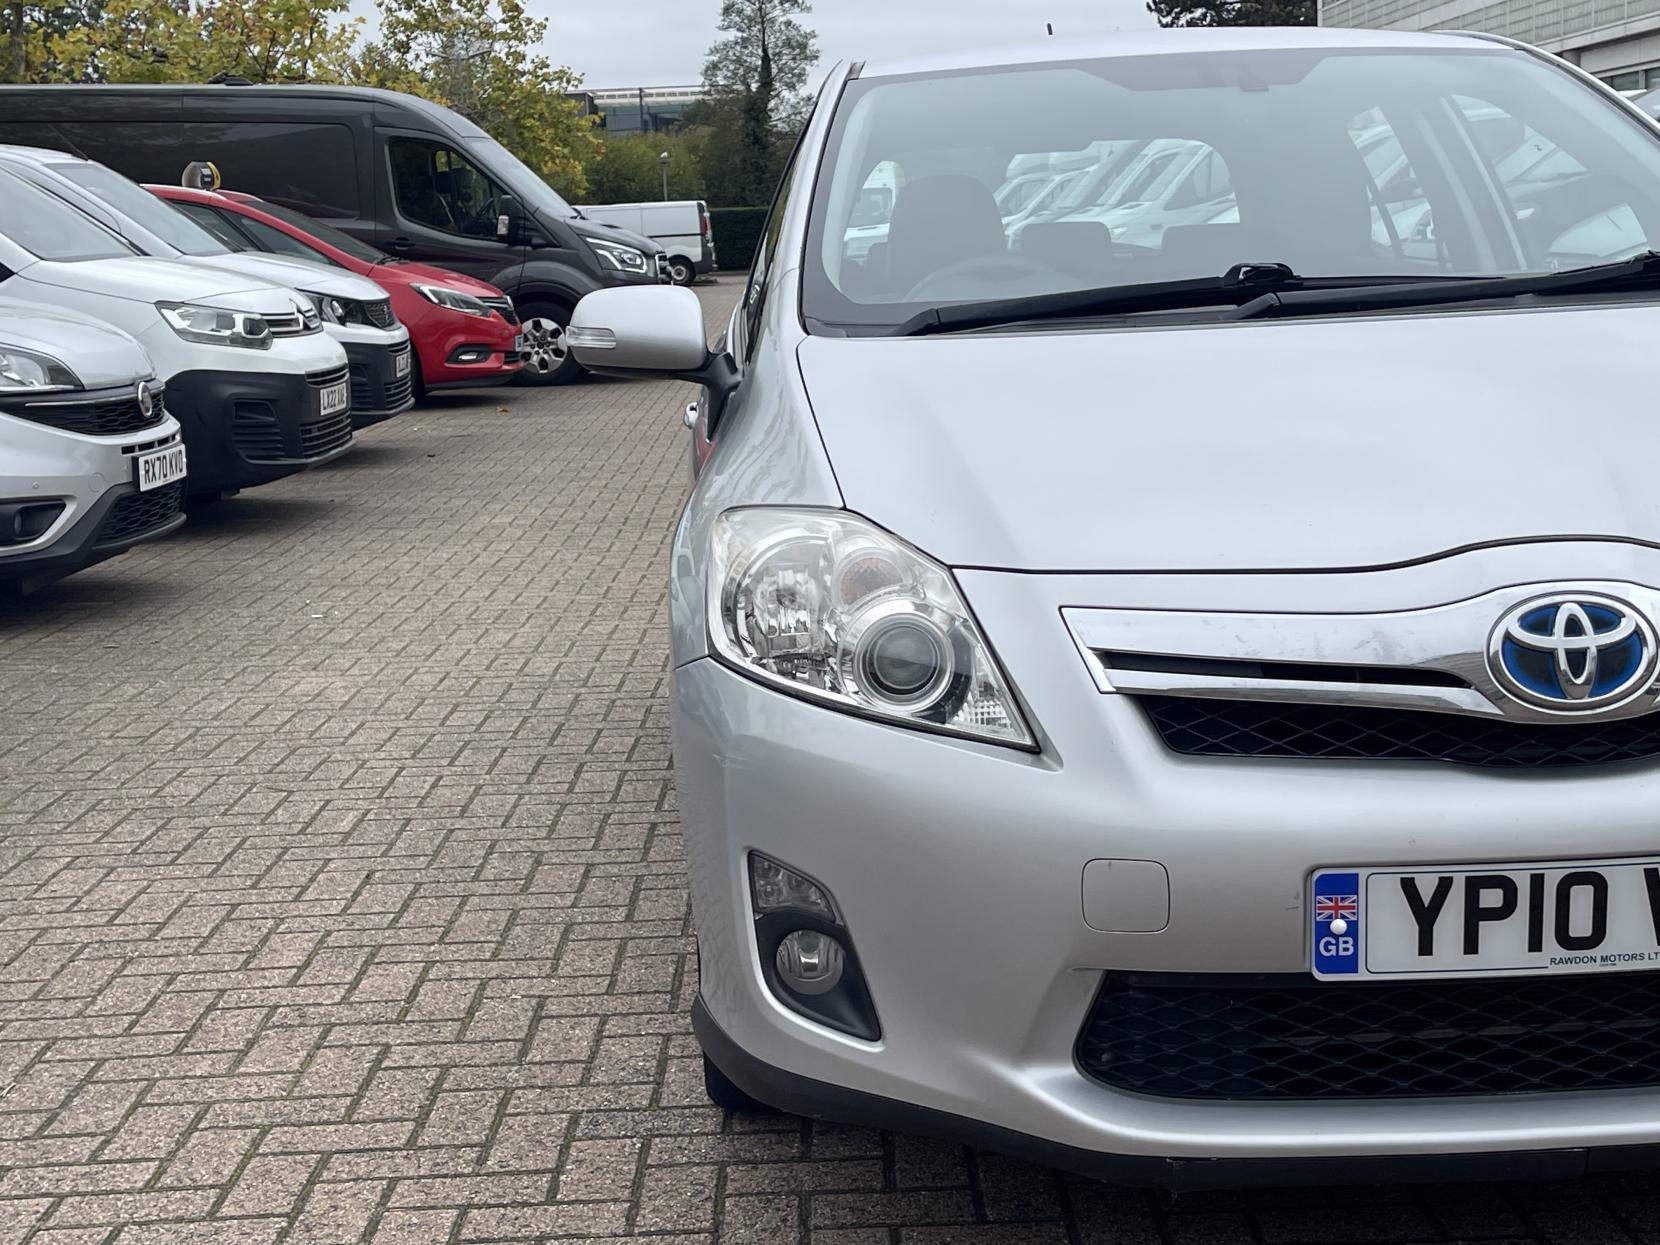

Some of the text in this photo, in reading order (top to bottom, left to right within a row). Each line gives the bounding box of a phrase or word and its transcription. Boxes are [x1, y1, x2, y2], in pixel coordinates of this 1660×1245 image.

[144, 454, 168, 485] RX70
[1400, 871, 1609, 957] YP10
[1319, 936, 1354, 957] GB
[1549, 955, 1597, 966] RAWDON
[1600, 952, 1645, 963] MOTORS
